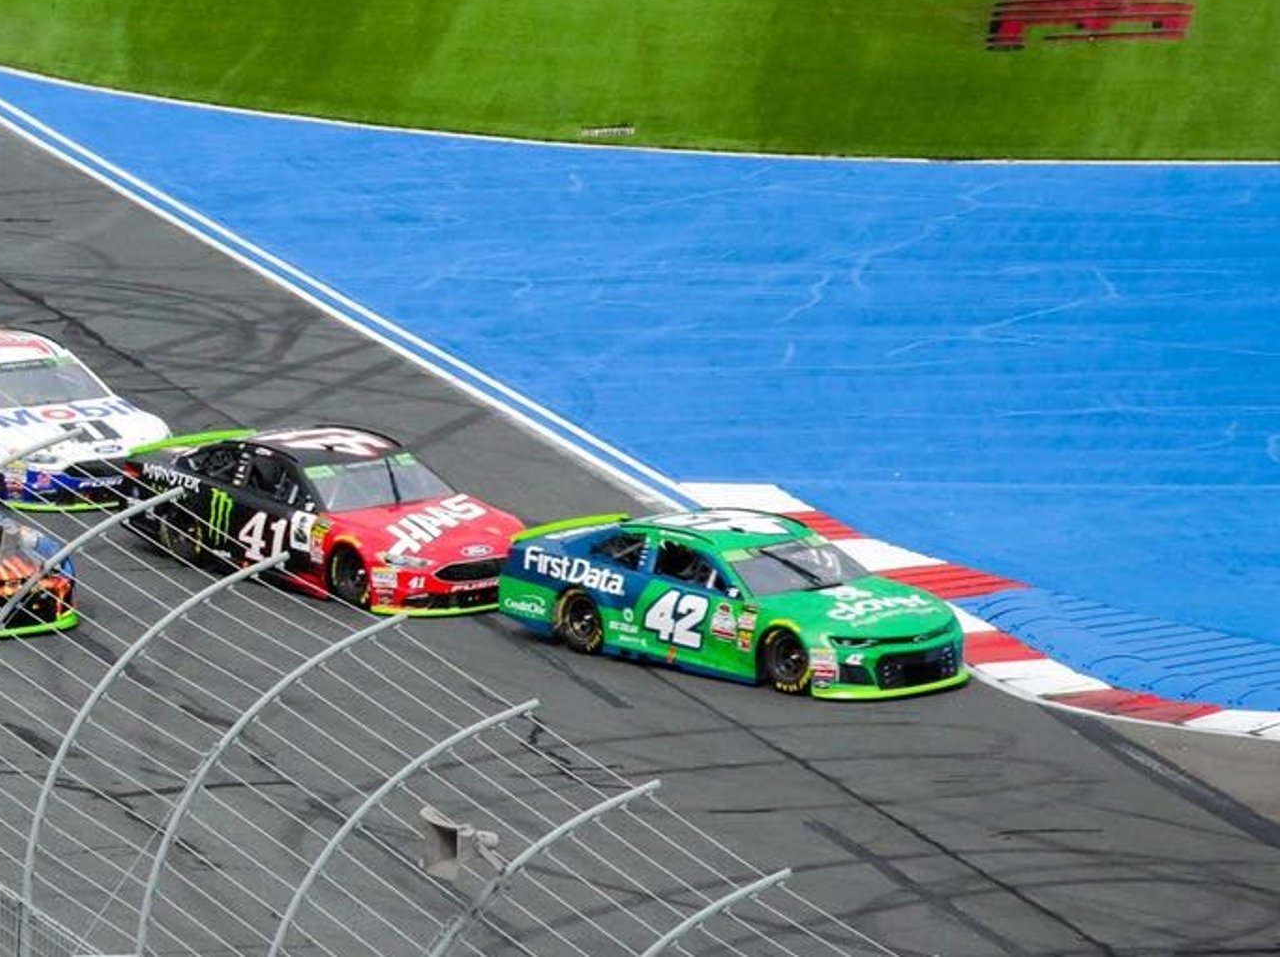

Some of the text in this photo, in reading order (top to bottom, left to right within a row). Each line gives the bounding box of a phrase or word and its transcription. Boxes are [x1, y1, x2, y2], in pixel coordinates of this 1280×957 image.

[142, 462, 202, 493] MONSTER
[238, 510, 289, 562] 41
[386, 493, 488, 556] HAAS
[407, 575, 426, 590] 41
[644, 589, 710, 650] 42
